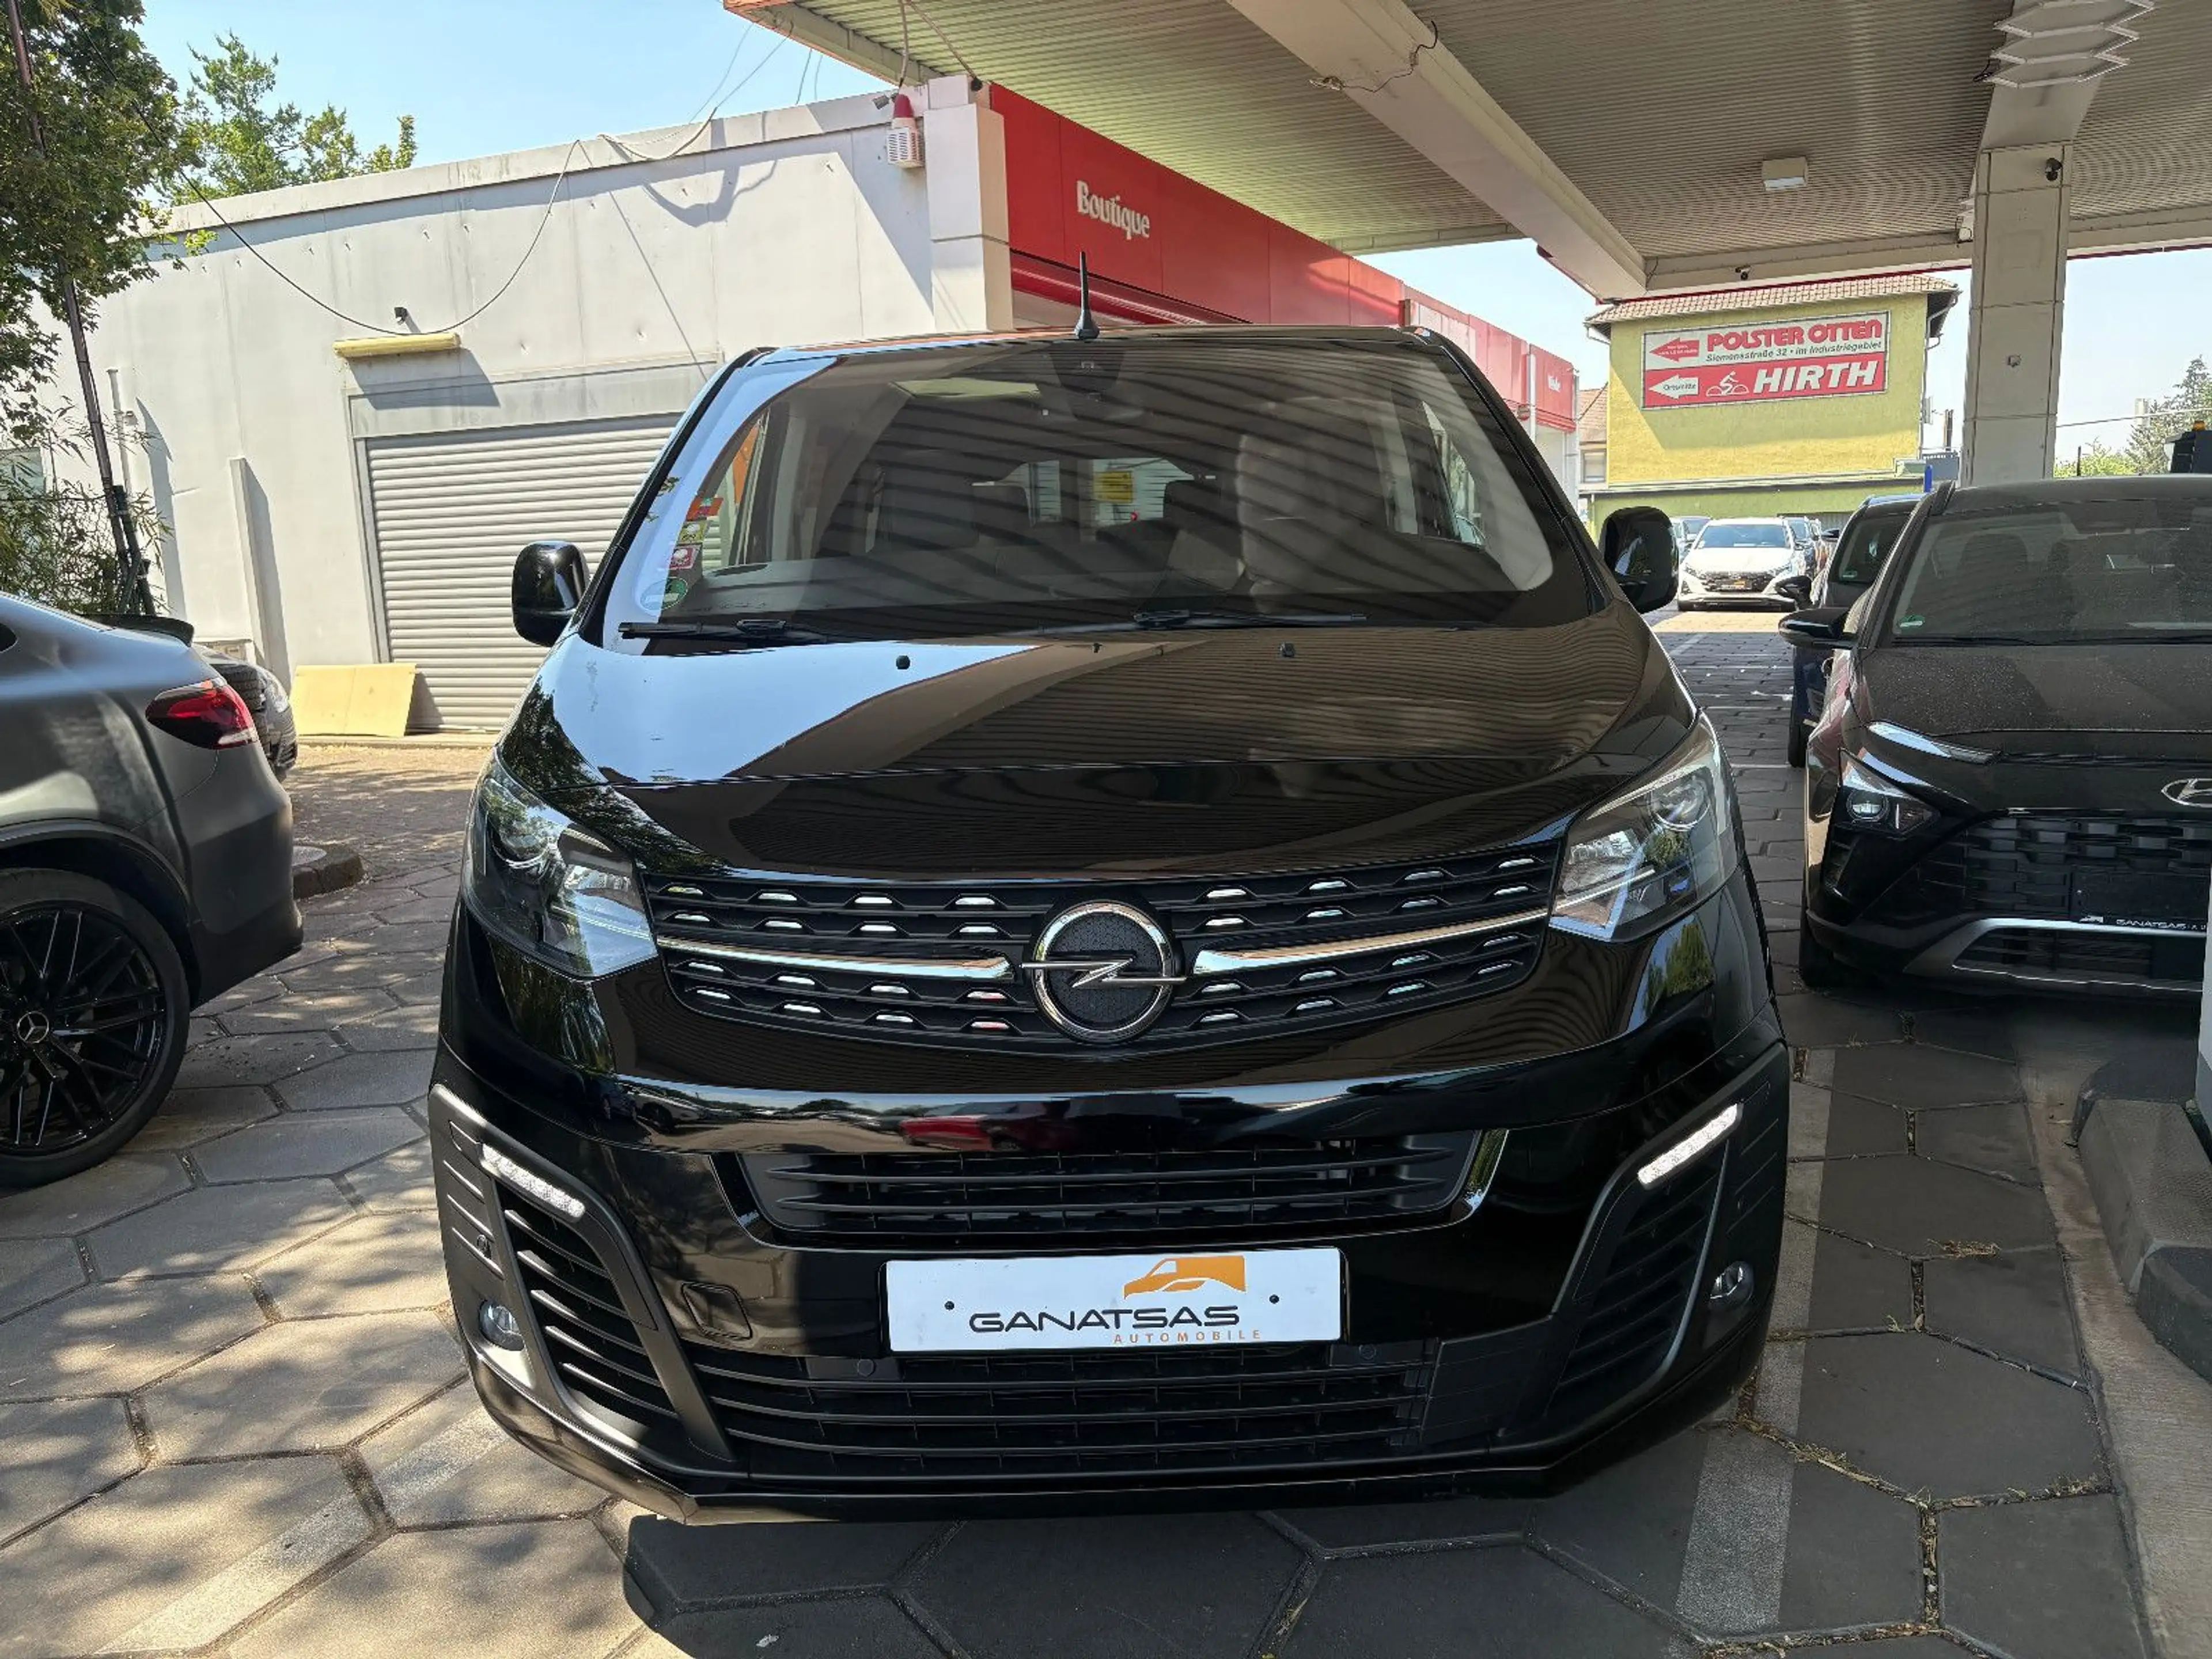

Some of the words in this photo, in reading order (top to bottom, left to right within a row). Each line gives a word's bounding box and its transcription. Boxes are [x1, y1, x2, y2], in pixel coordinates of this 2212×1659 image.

[1076, 180, 1150, 240] Boutique
[1707, 326, 1804, 352] POLSTER
[1776, 348, 1787, 357] 32
[1795, 347, 1806, 355] im
[1753, 360, 1878, 394] HIRTH
[969, 1305, 1240, 1333] GANATSAS
[1113, 1329, 1261, 1344] AUTOMOBILE
